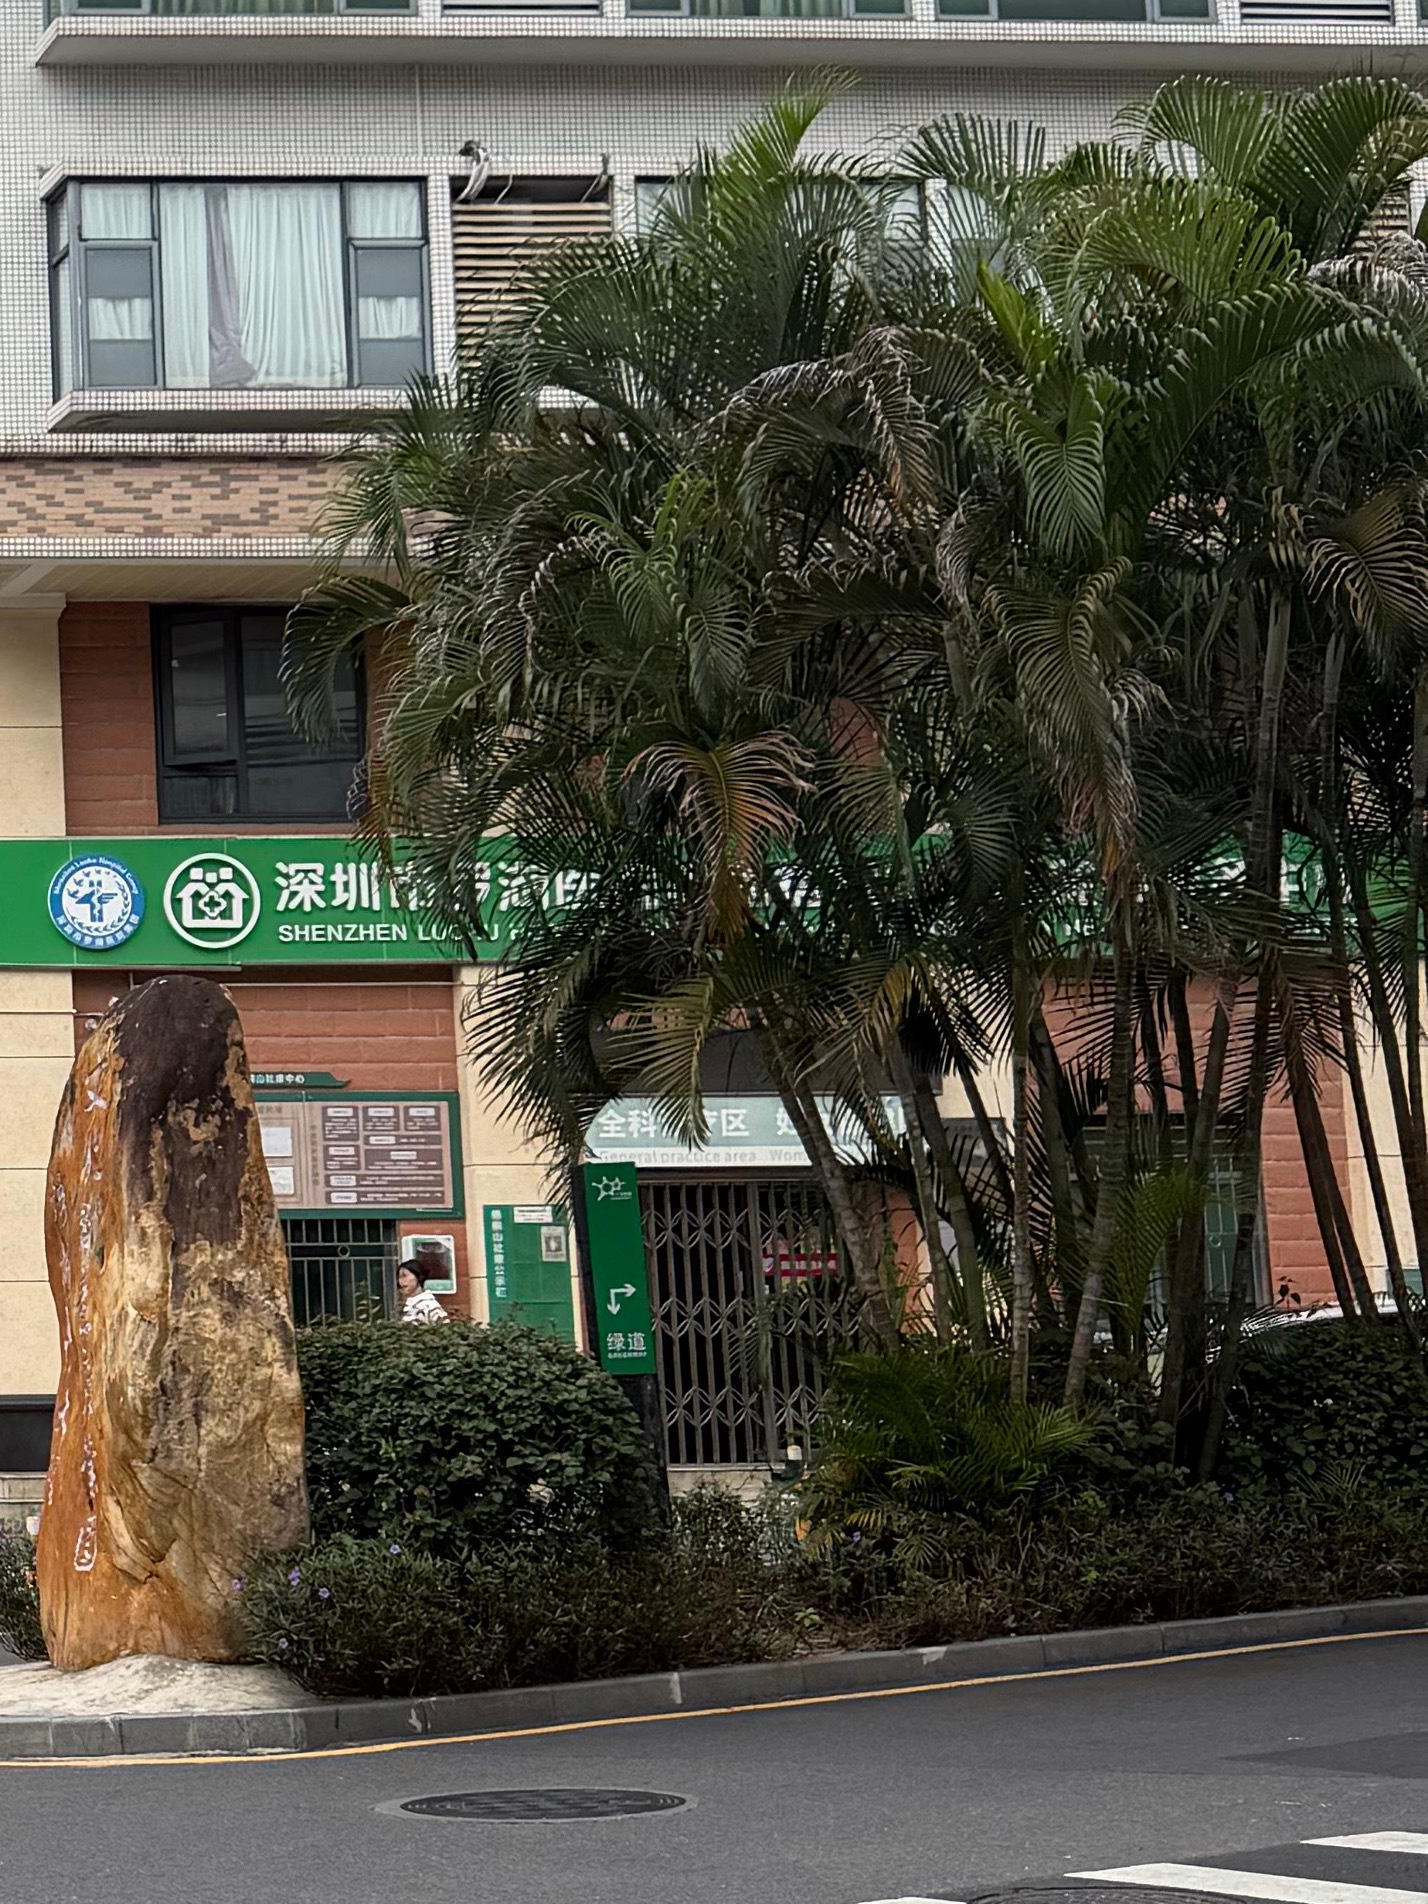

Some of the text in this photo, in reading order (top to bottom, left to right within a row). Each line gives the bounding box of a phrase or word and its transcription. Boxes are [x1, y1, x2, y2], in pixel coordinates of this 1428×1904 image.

[278, 924, 407, 942] SHENZHEN
[250, 1073, 305, 1085] 山社康中心
[597, 1108, 750, 1138] 全科区
[724, 1152, 756, 1162] area
[606, 1332, 647, 1351] 绿道
